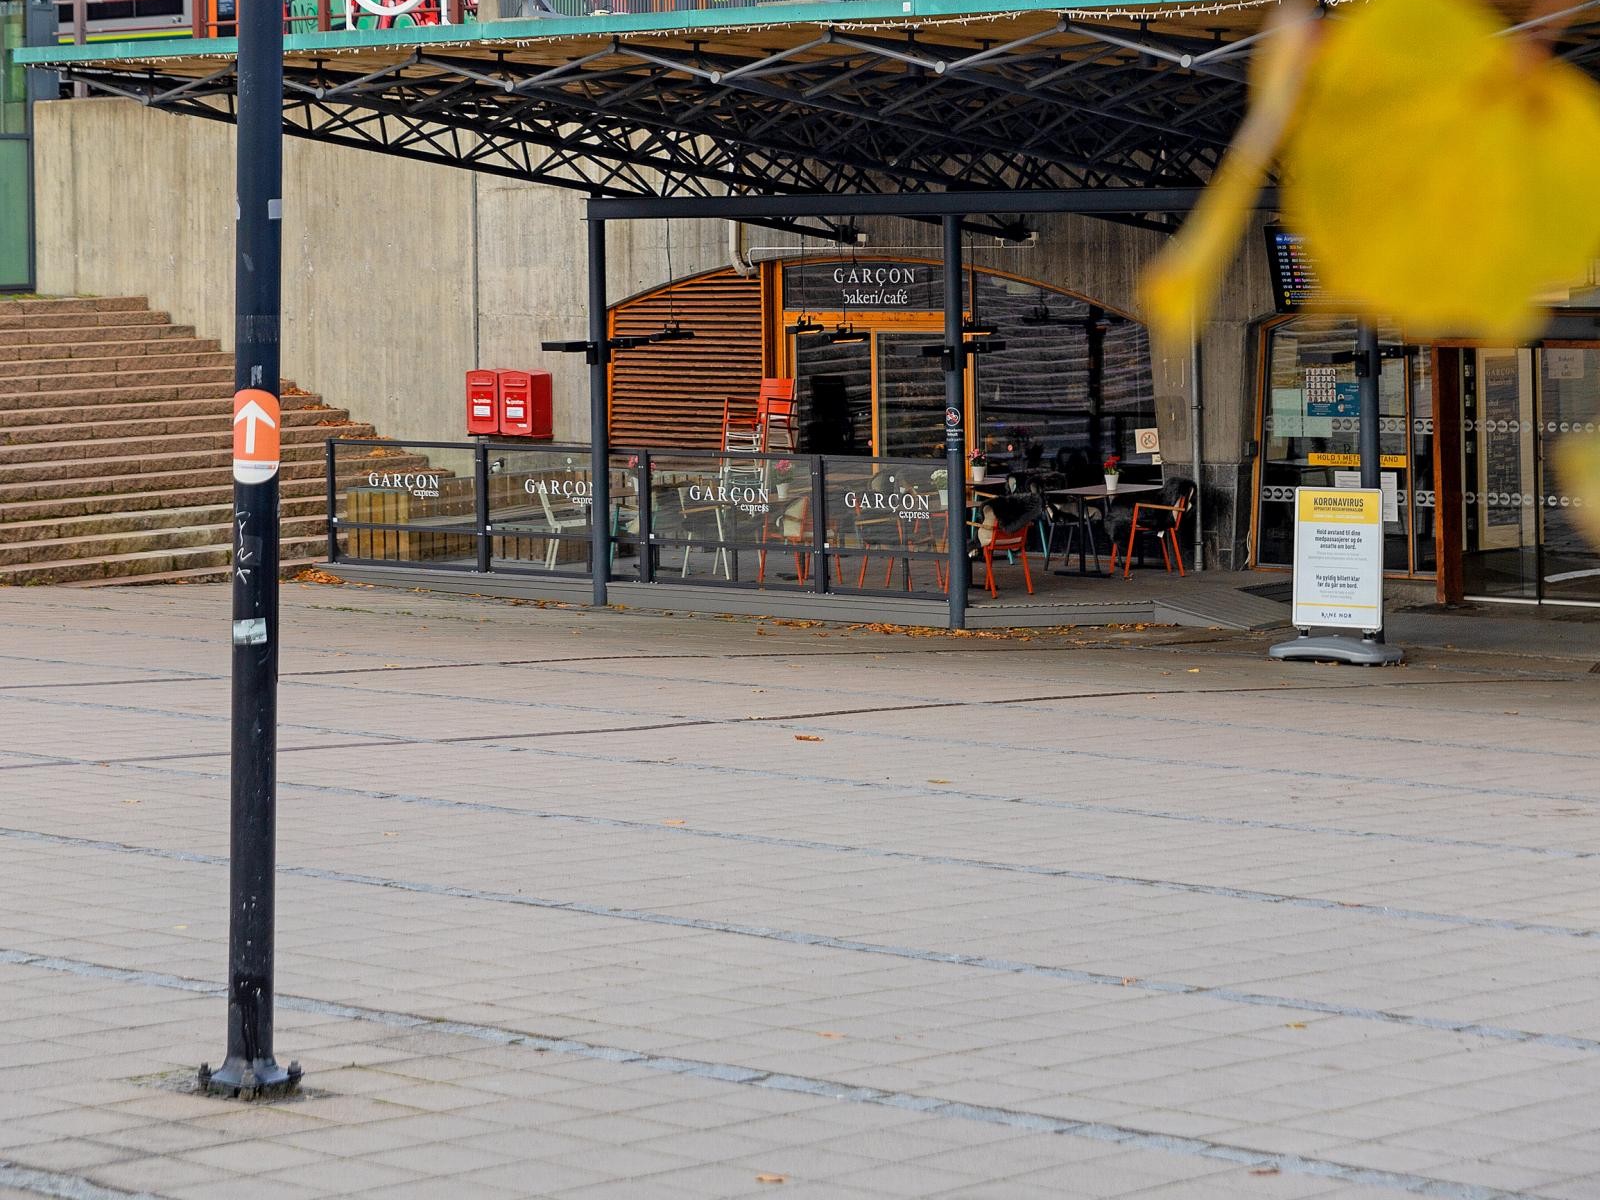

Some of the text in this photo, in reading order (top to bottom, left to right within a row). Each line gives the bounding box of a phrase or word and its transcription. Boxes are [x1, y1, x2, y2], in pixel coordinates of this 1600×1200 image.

[834, 268, 915, 286] GARÇON
[842, 289, 908, 304] bakeri/café
[368, 472, 439, 491] GARÇON
[525, 479, 592, 498] GARÇO
[414, 490, 440, 500] express
[572, 496, 592, 508] expre
[690, 486, 769, 505] GARÇON
[845, 492, 929, 512] GARÇON
[1314, 498, 1364, 507] KORONAVIRUS
[740, 503, 769, 514] express
[899, 511, 930, 522] express
